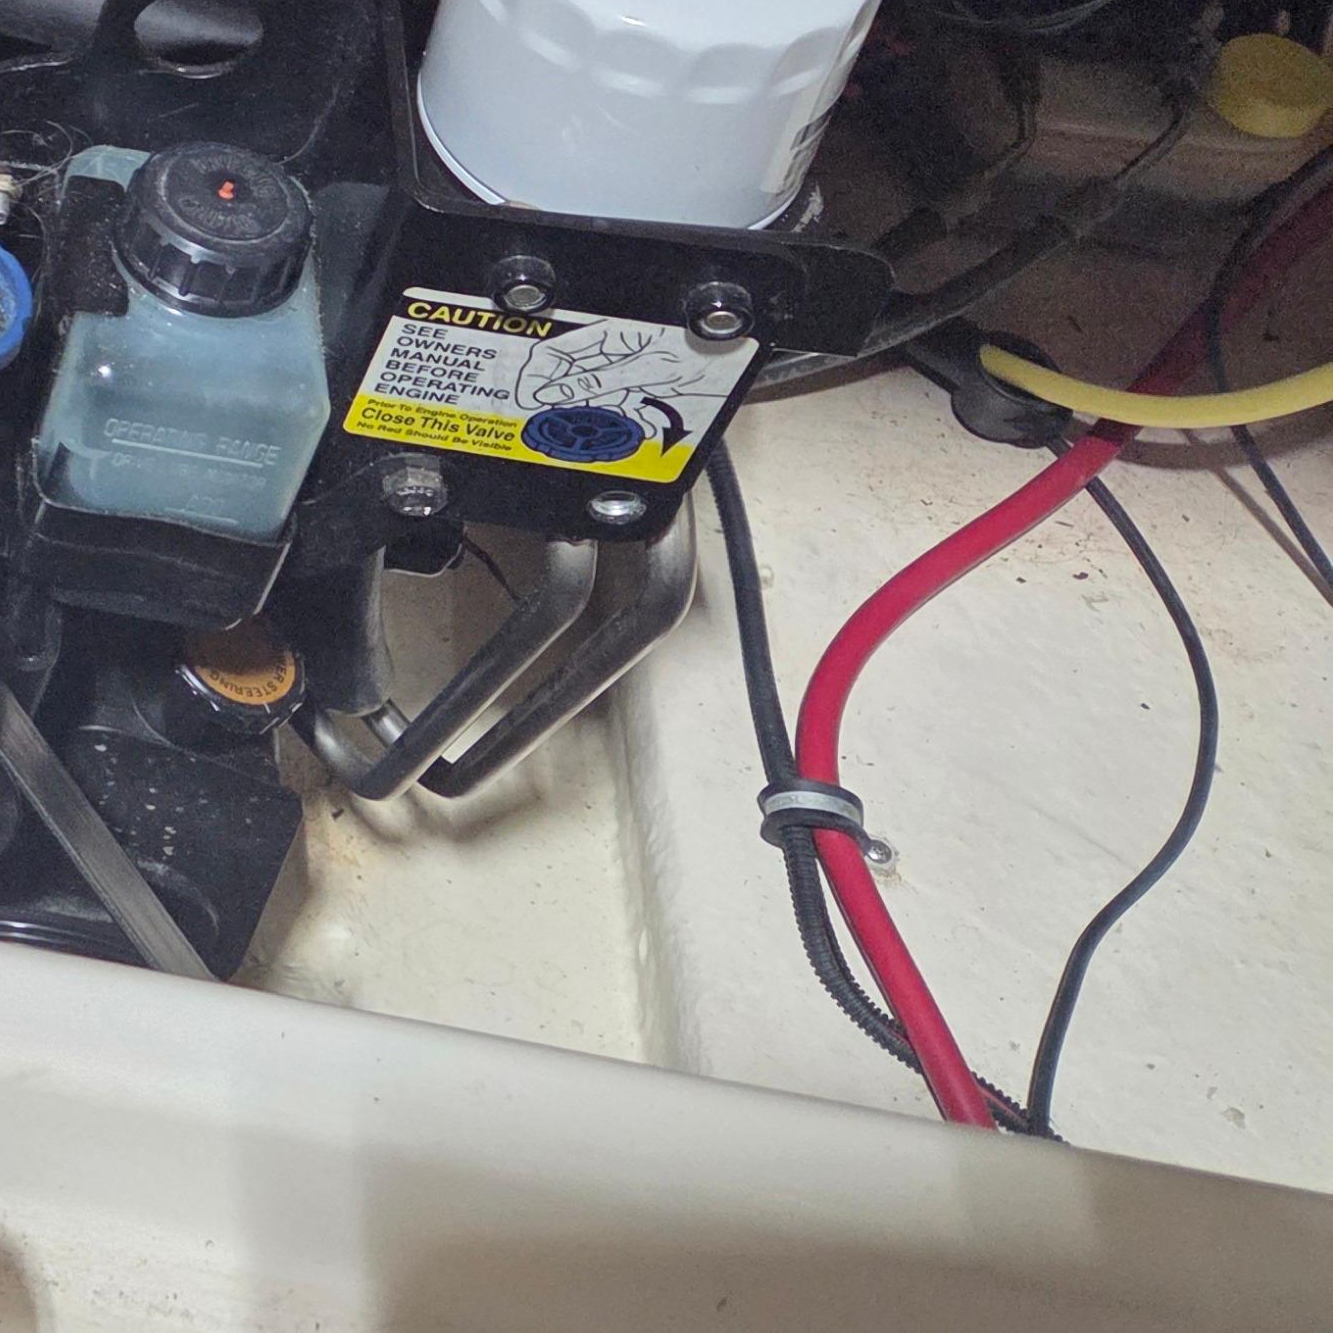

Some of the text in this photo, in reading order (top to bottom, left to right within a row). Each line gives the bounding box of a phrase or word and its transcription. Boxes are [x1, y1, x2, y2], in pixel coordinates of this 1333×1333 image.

[402, 323, 448, 339] SEE
[408, 302, 552, 337] CAUTION
[390, 348, 486, 372] MANUAL
[397, 336, 498, 360] OWNERS
[385, 359, 479, 383] BEFORE
[374, 383, 460, 405] ENGINE
[379, 371, 511, 400] OPERATING
[361, 407, 515, 442] Close This Valve
[367, 399, 518, 428] Prior To Engine Operation
[356, 420, 513, 452] No Red Should Be Visible
[215, 436, 282, 466] RANGE
[209, 669, 278, 697] STEERING
